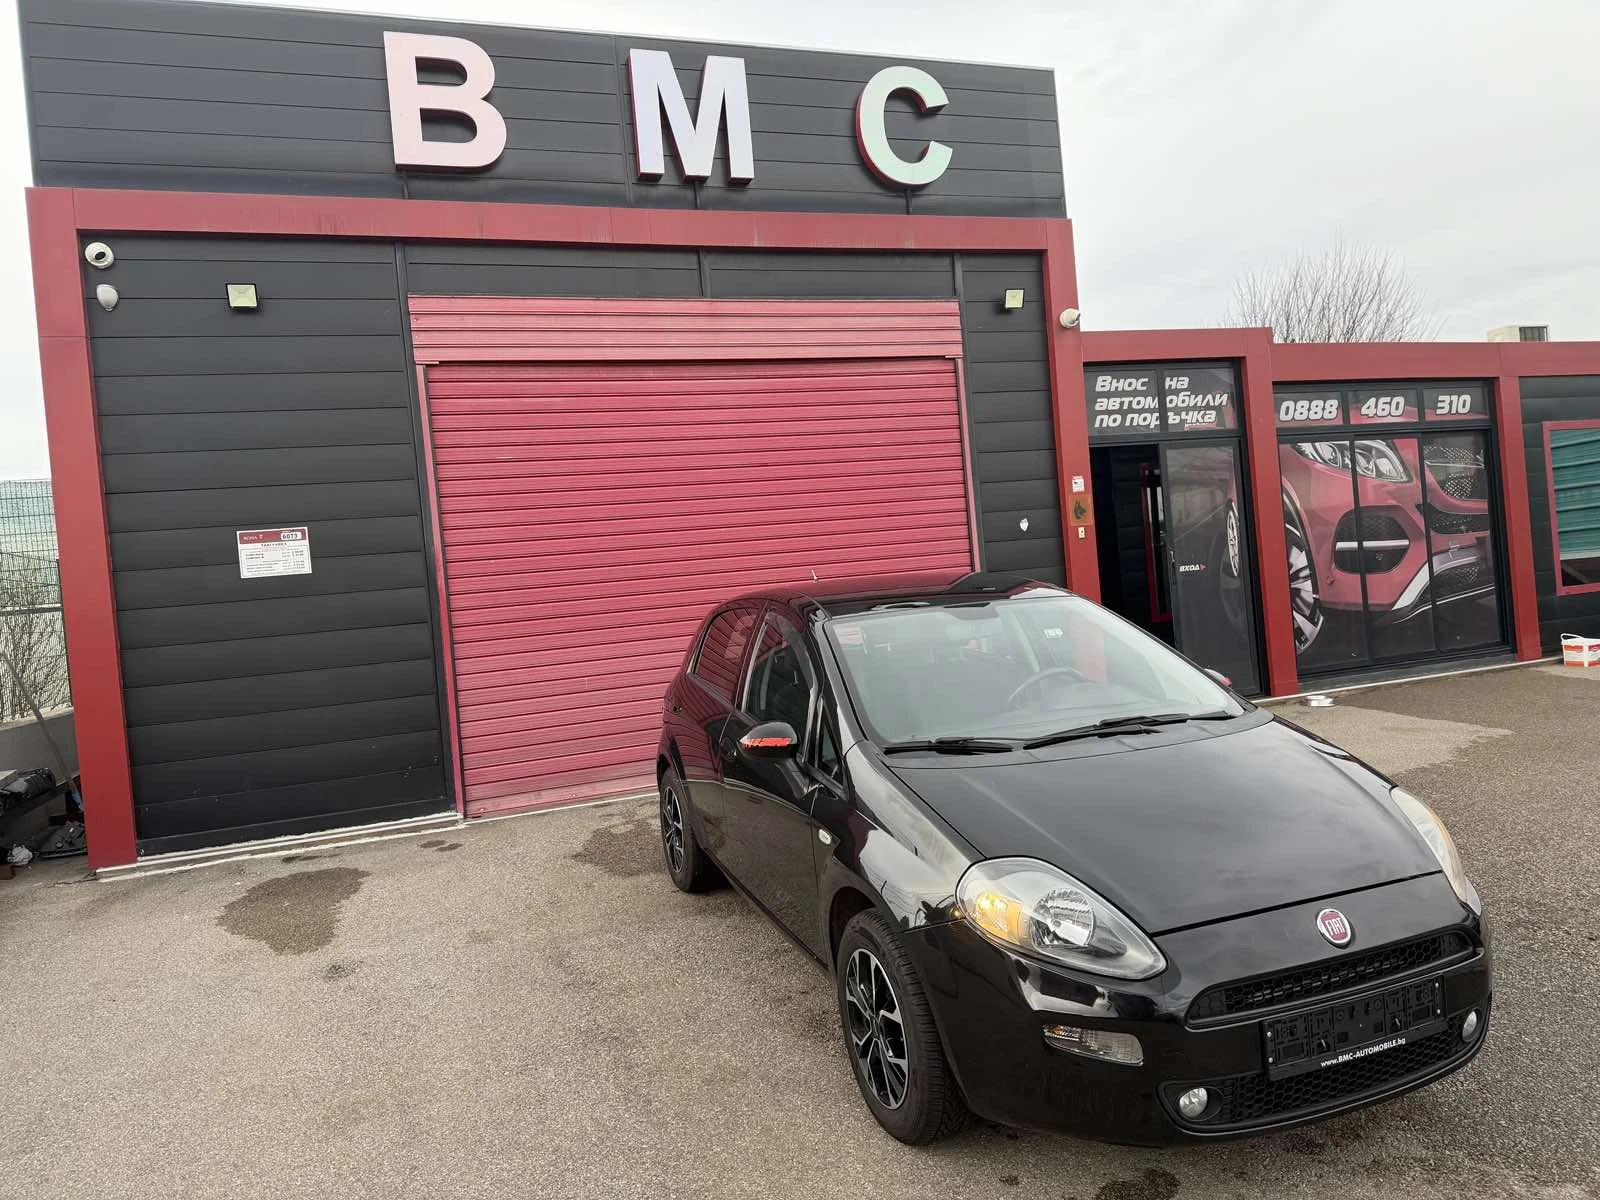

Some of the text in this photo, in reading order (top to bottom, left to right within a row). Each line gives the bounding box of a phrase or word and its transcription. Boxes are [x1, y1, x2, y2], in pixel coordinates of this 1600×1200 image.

[1095, 375, 1190, 392] Внос на
[1279, 394, 1472, 421] 0888 460 310
[1094, 413, 1122, 428] по
[1324, 917, 1346, 936] FIAT
[1320, 1037, 1406, 1068] www.BMC-AUTOMOBILE.bg
